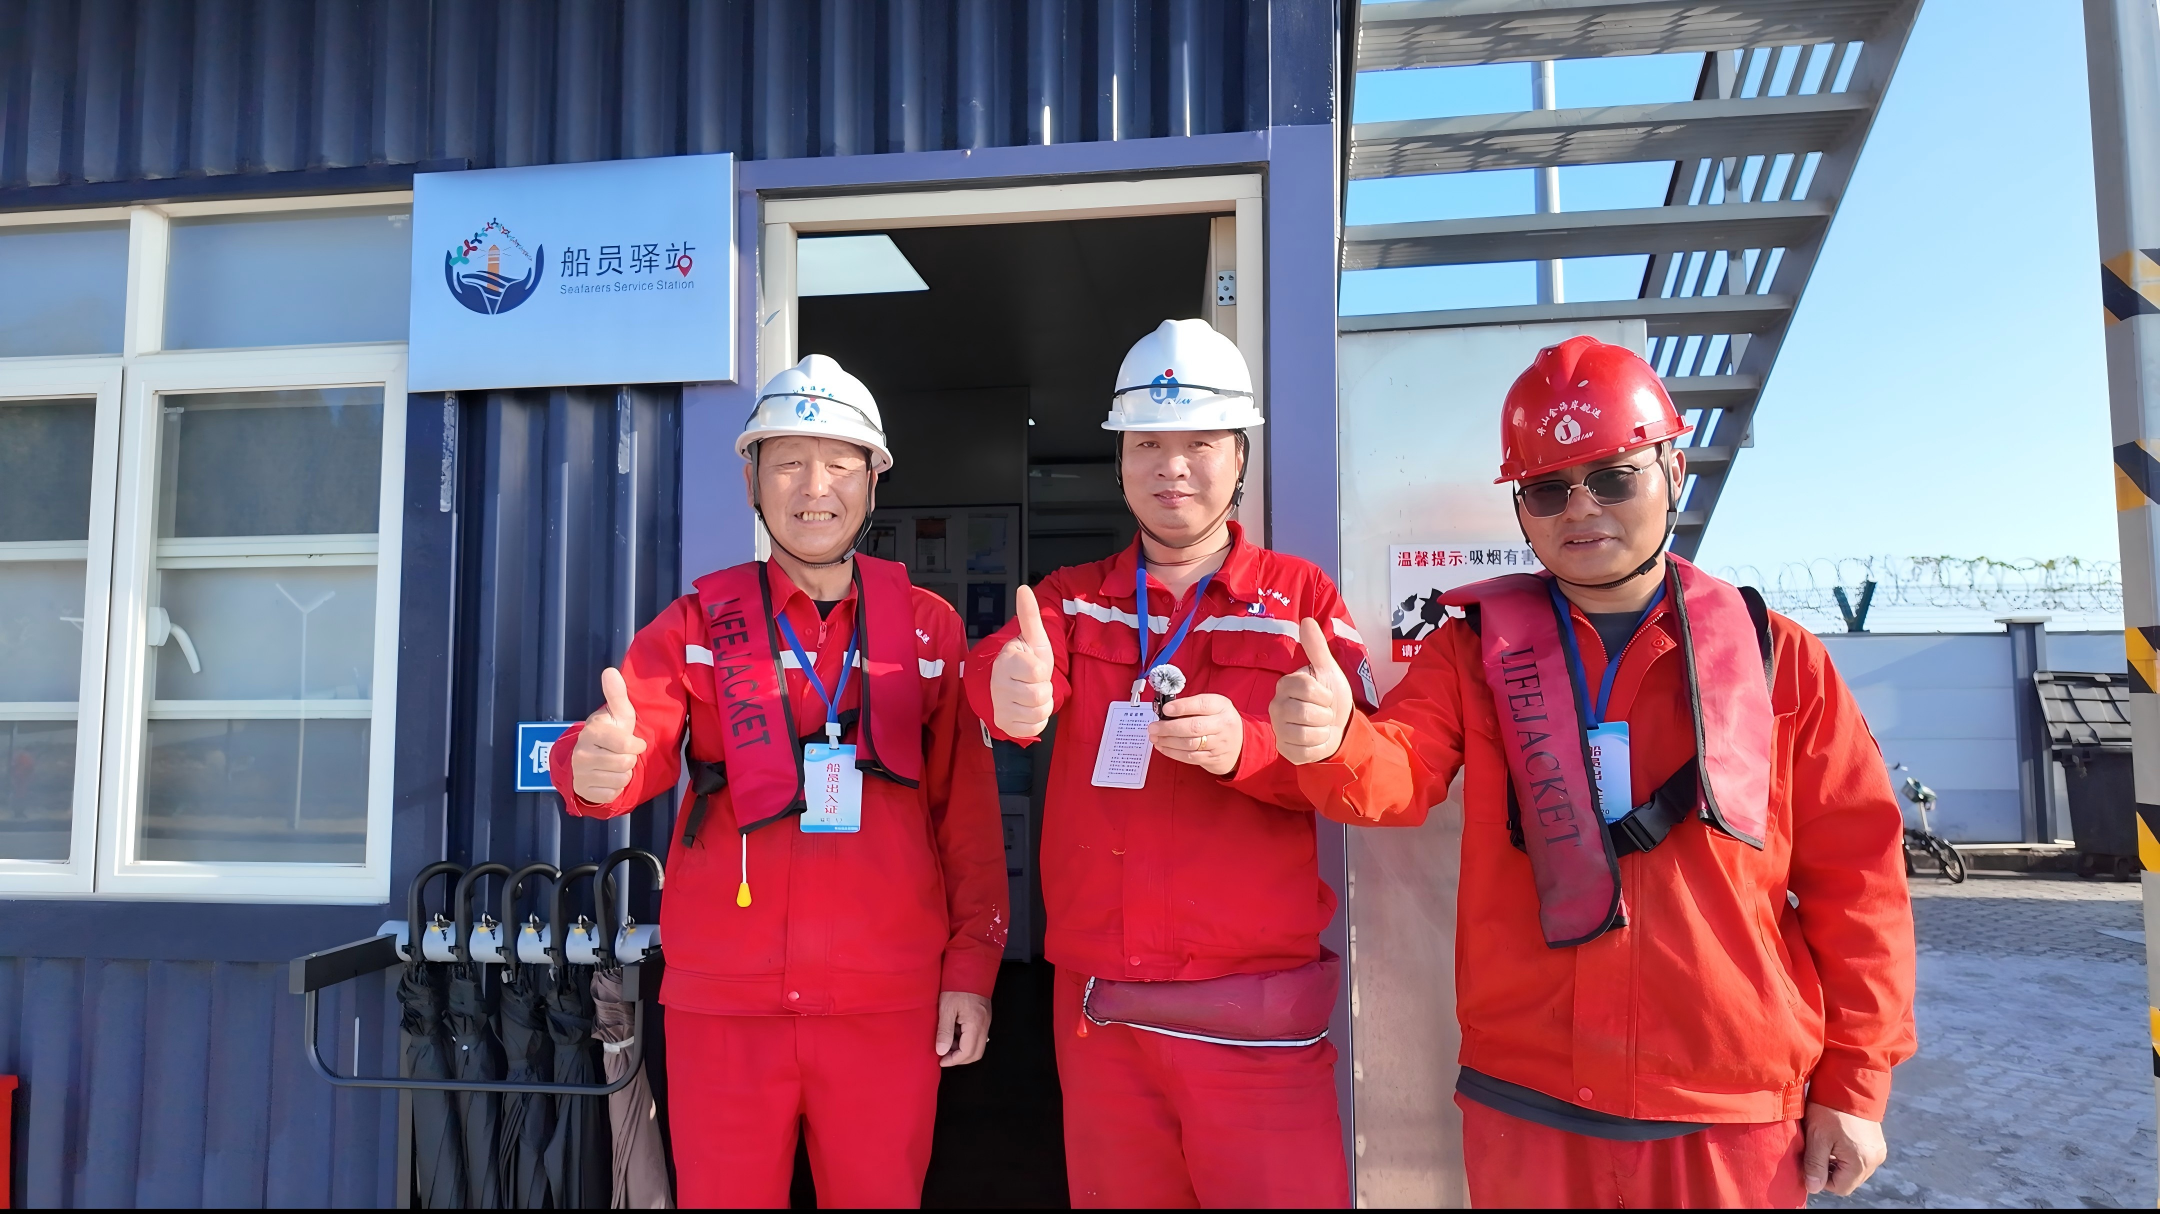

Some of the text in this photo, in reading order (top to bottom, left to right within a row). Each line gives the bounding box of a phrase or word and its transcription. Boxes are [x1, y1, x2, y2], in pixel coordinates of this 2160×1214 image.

[561, 241, 696, 277] 船员驿站
[560, 279, 695, 294] Seafarers Service Station
